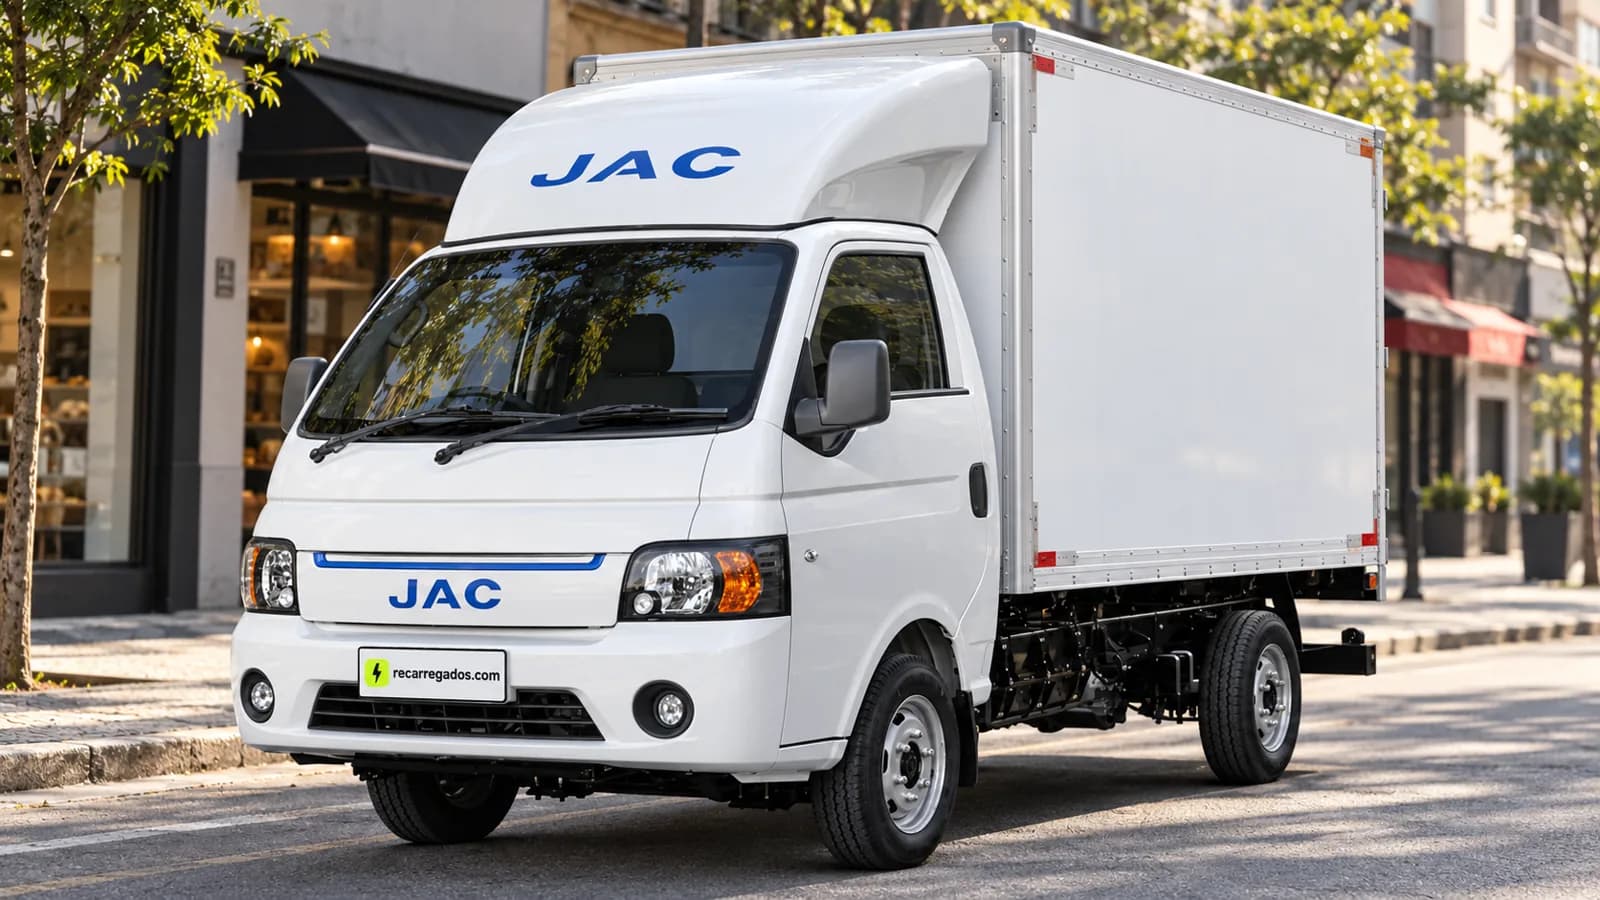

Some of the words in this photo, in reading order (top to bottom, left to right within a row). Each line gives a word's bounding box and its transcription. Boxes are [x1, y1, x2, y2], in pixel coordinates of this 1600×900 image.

[530, 146, 741, 188] JAC
[389, 578, 501, 610] JAC
[393, 668, 500, 682] recarregados.com
